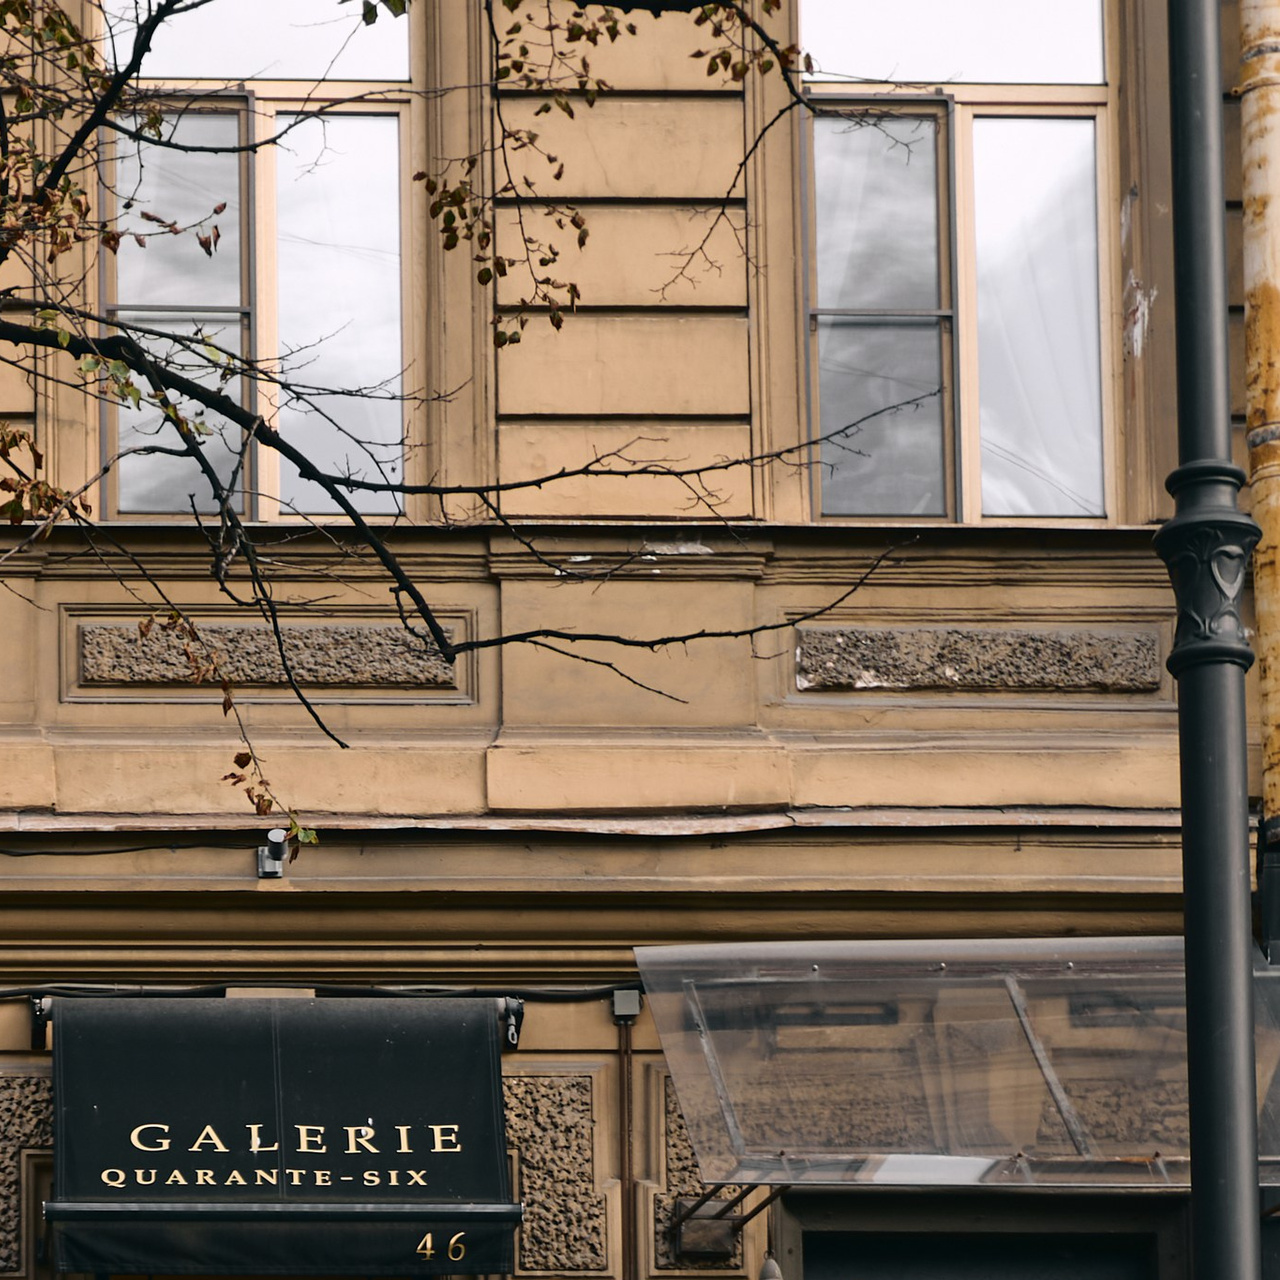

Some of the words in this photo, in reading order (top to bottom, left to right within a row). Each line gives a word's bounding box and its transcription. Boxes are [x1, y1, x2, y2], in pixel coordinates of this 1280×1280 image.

[129, 1123, 463, 1154] GALERIE
[100, 1168, 429, 1188] QUARANTE-SIX
[416, 1231, 466, 1261] 46
